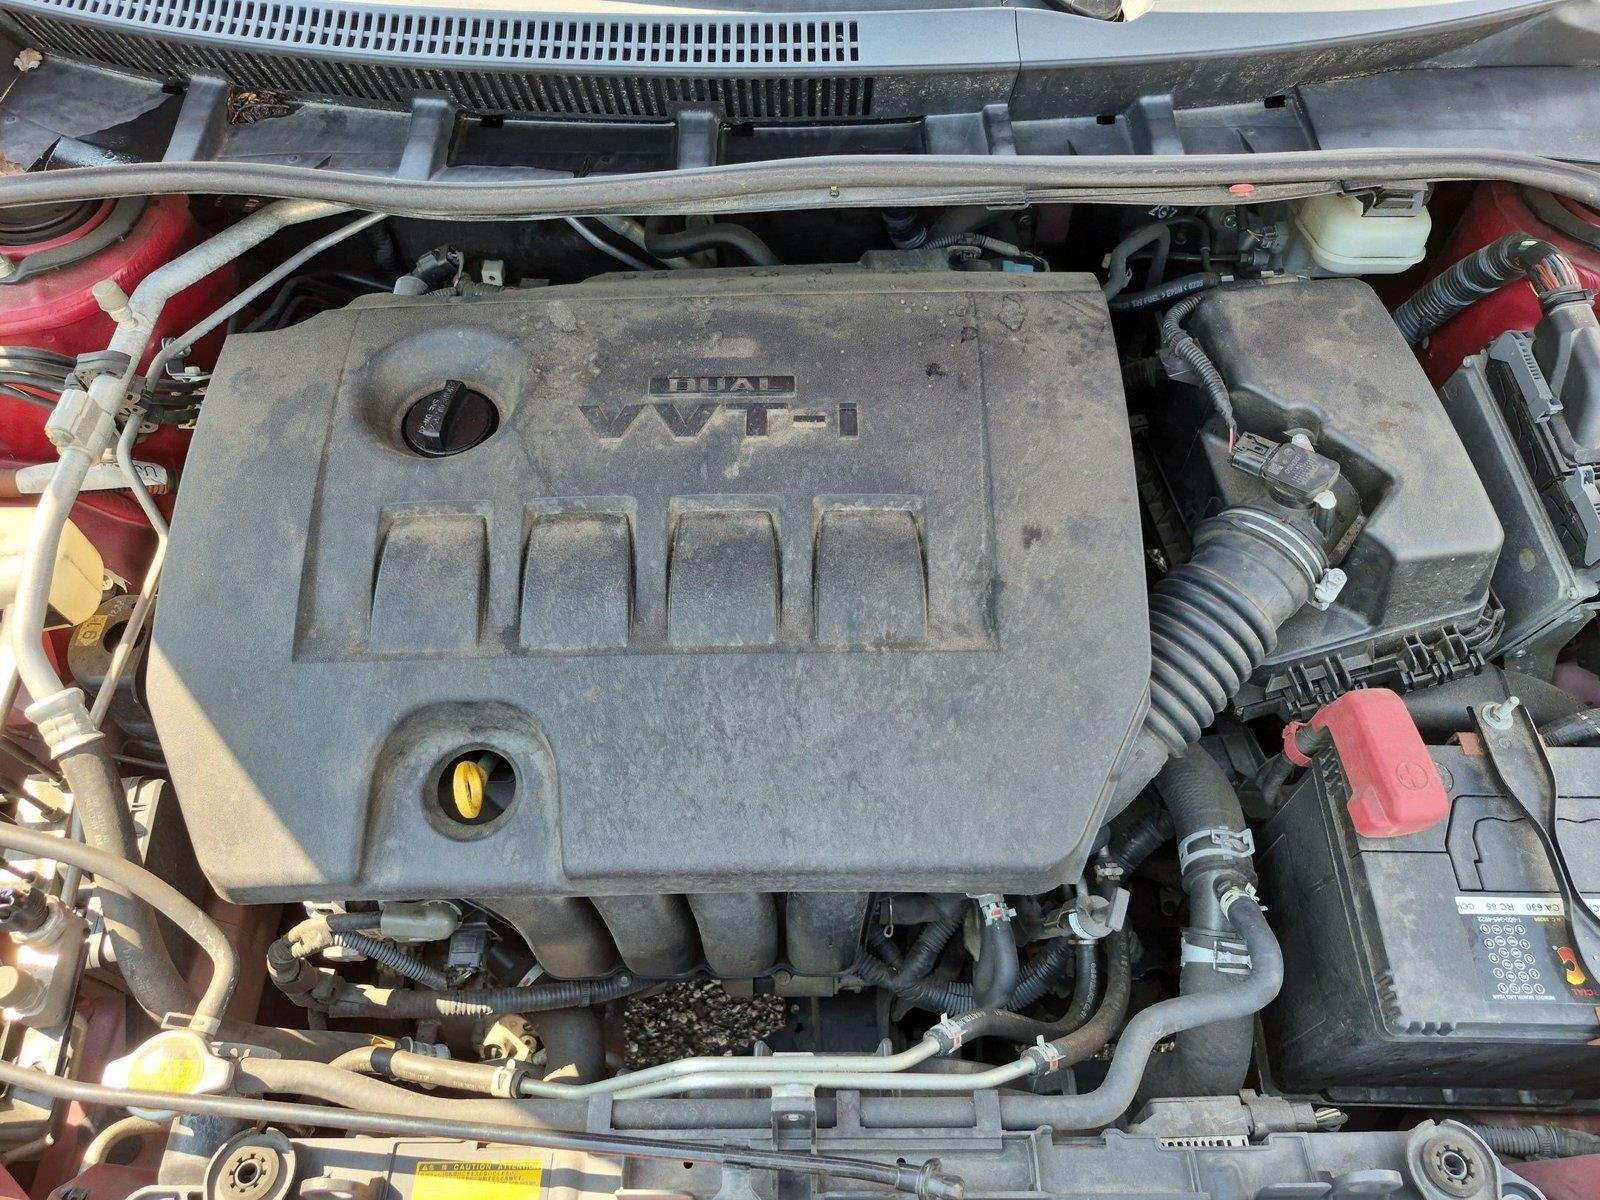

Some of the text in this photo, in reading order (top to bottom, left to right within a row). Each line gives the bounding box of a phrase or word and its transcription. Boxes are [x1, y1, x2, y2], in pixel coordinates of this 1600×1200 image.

[669, 376, 781, 392] DUAL
[1500, 902, 1515, 911] RC
[1526, 903, 1543, 911] 630
[1545, 903, 1560, 912] CA
[453, 1162, 491, 1171] CAUTION
